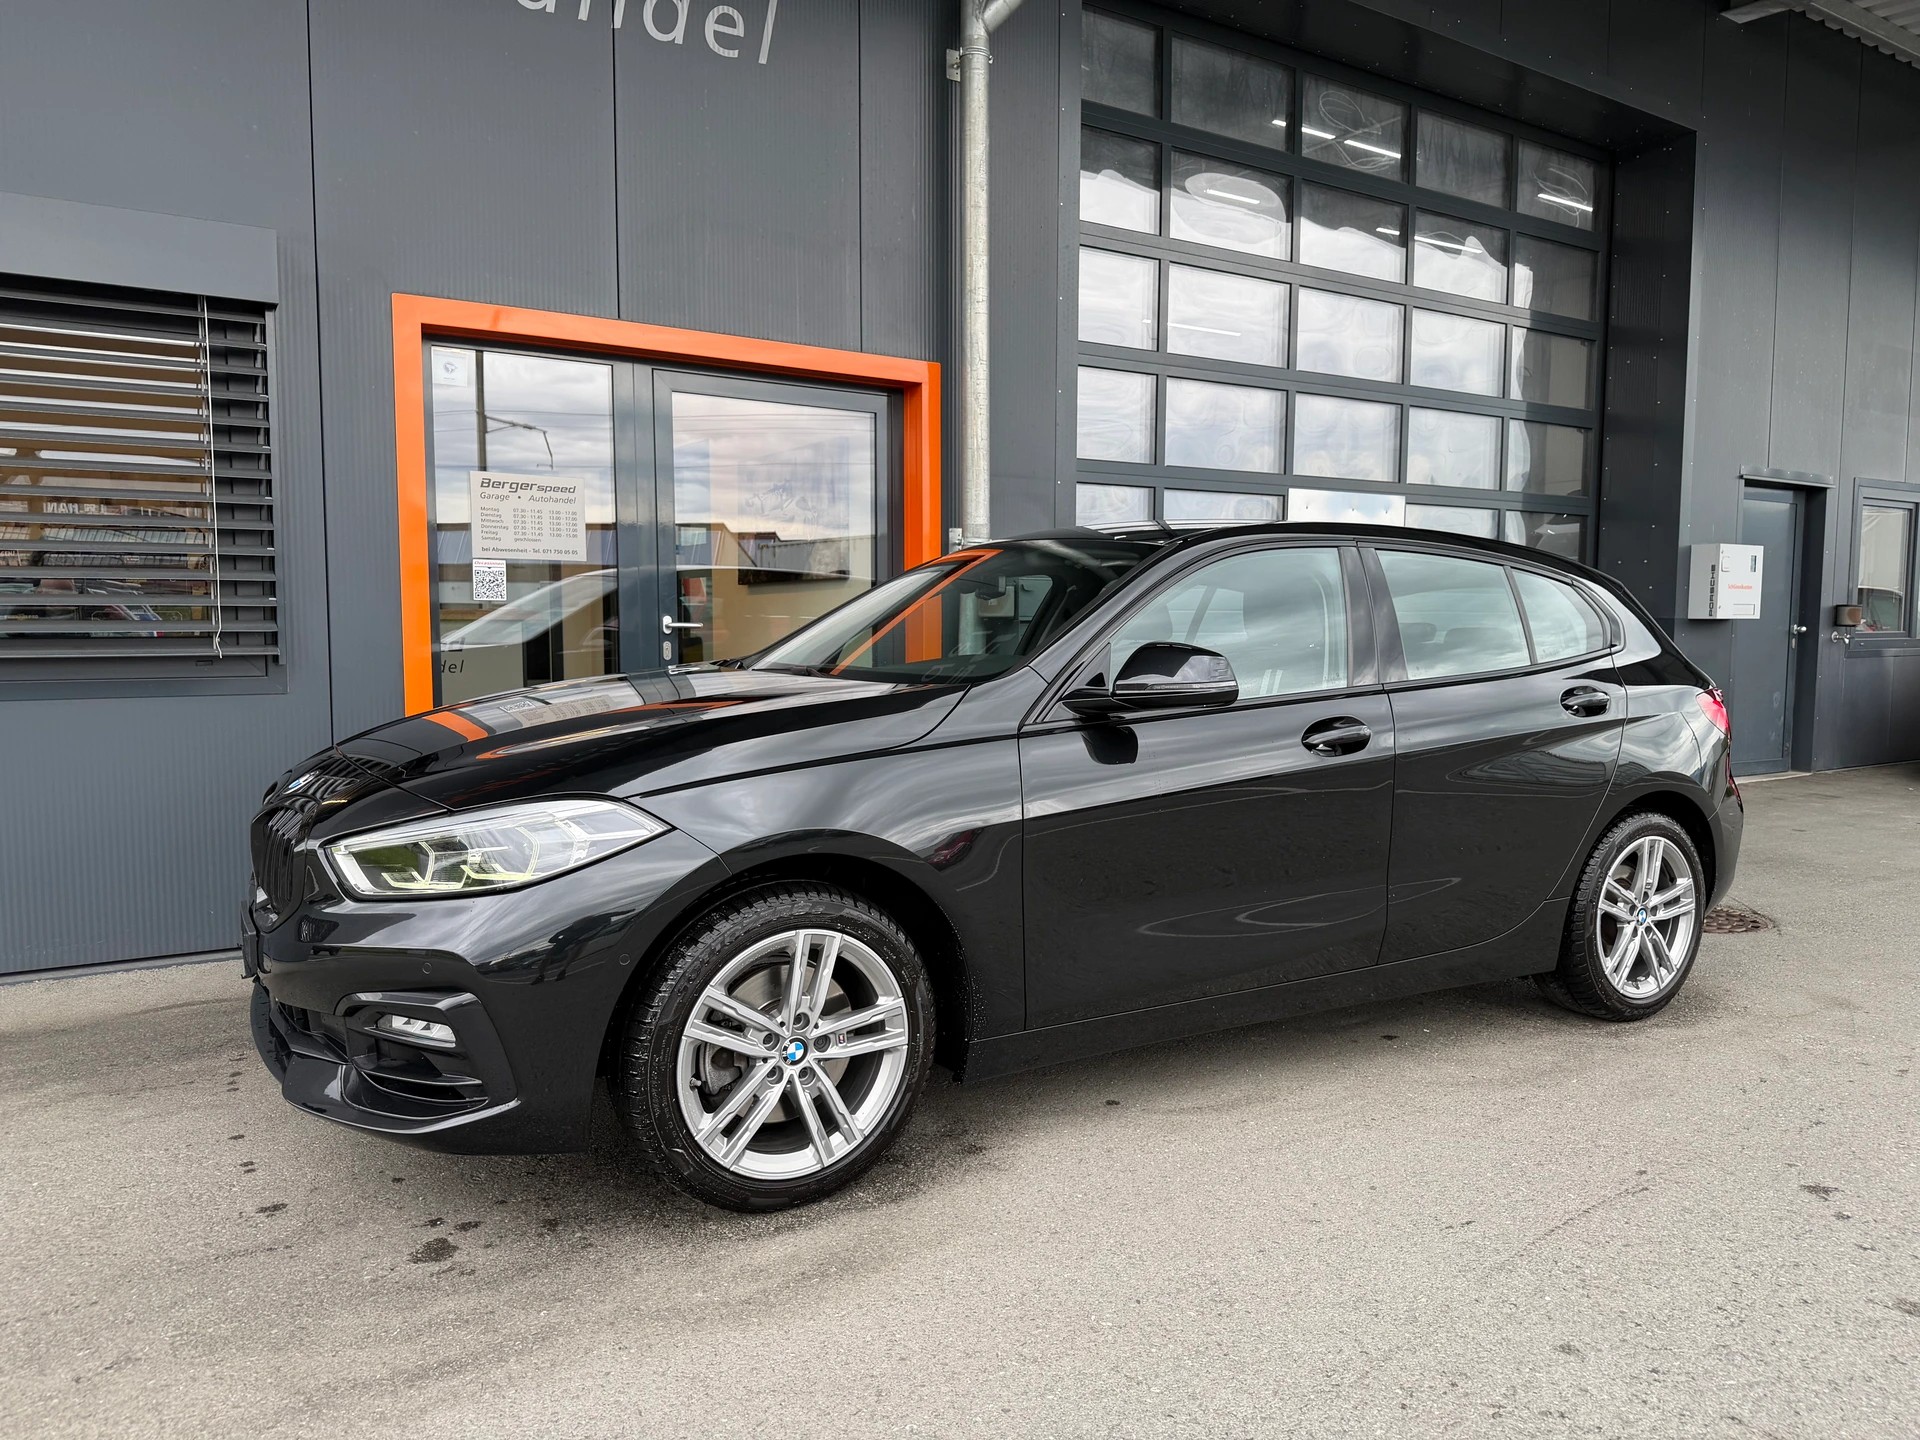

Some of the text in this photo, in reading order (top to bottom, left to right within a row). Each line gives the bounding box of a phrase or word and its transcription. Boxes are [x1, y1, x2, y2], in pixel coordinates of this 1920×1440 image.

[480, 477, 577, 493] Bergerspeed
[480, 491, 577, 504] Garage Autohandel
